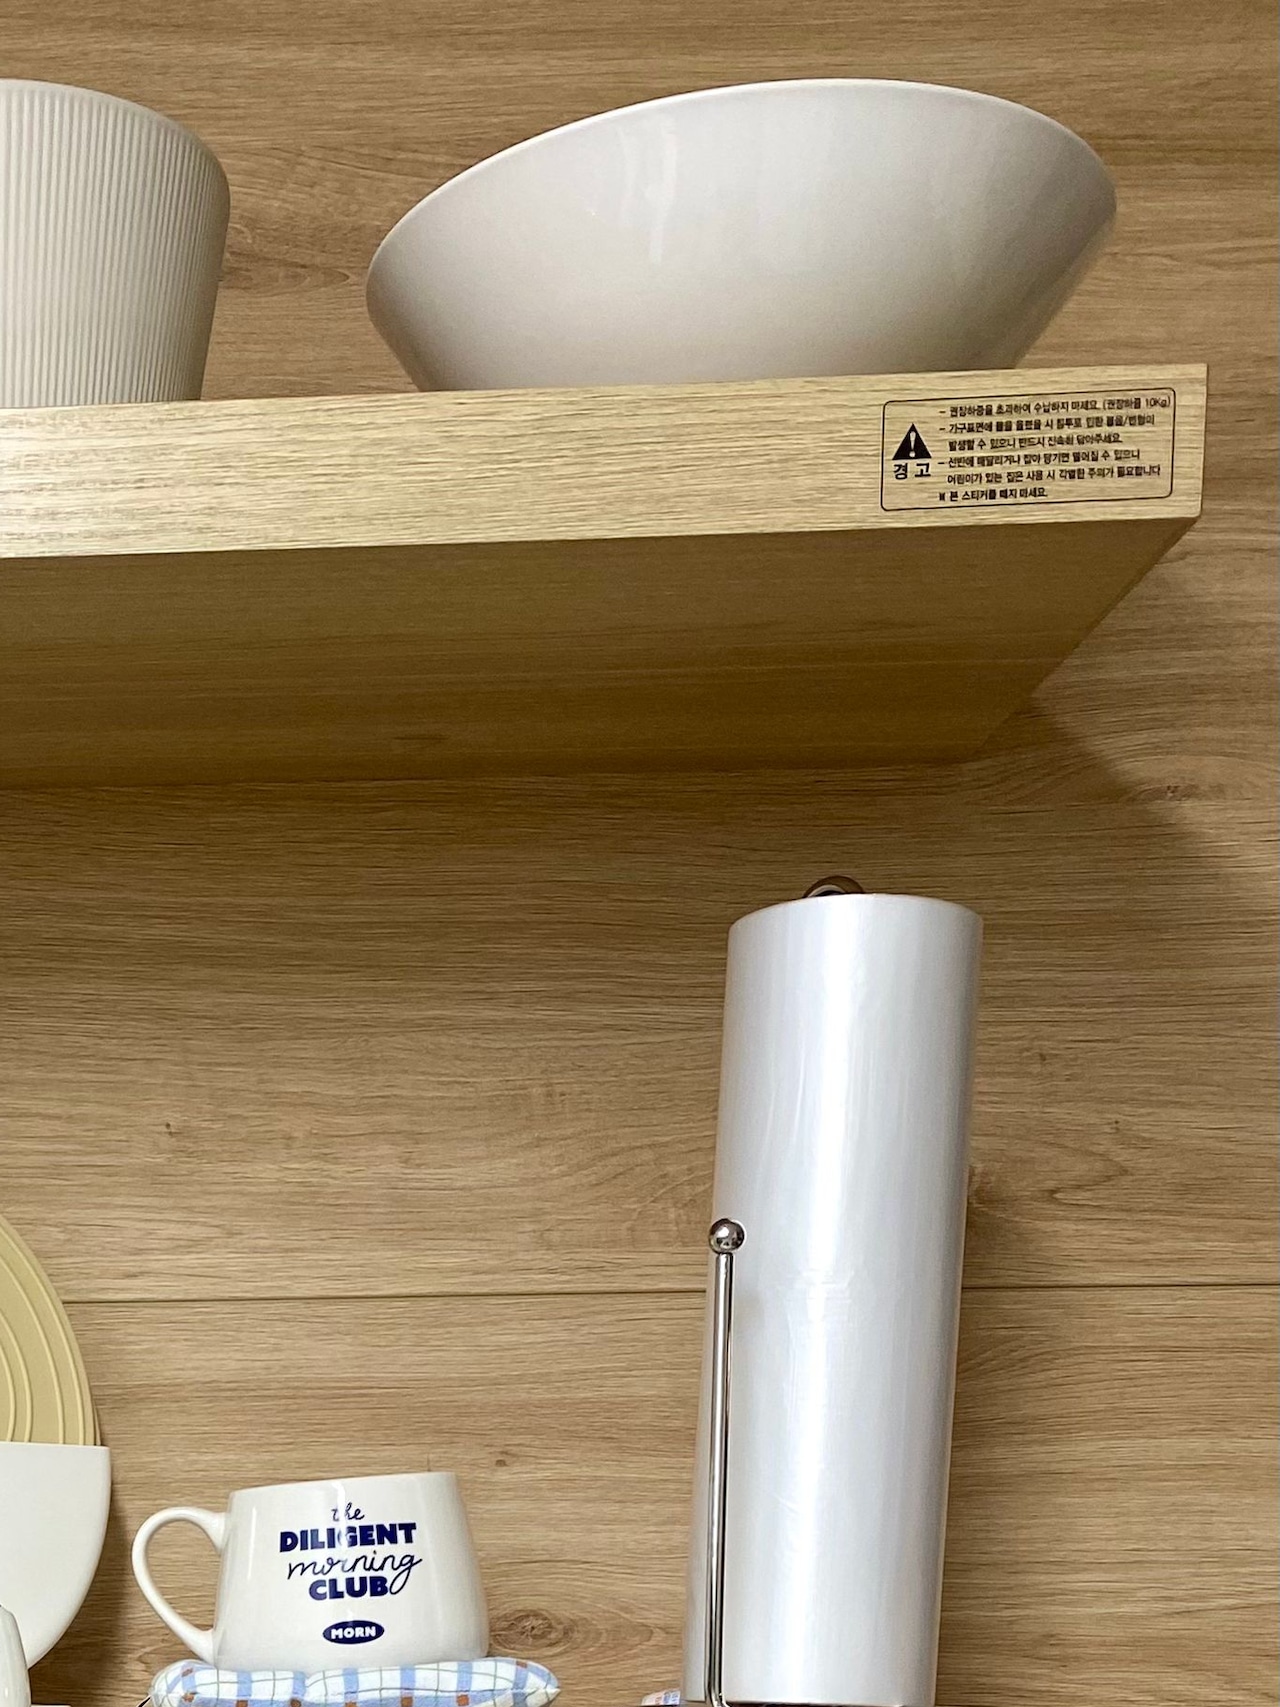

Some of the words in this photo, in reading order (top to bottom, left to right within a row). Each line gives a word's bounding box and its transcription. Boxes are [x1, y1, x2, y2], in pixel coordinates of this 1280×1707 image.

[995, 403, 1031, 415] 초과하여
[949, 421, 993, 434] 가구표면에
[1044, 418, 1053, 430] 시
[977, 438, 986, 450] 수
[990, 437, 1016, 449] 있으니
[1018, 436, 1045, 448] 반드시
[948, 456, 974, 468] 선반에
[977, 454, 1020, 467] 매달리거나
[1043, 452, 1070, 465] 당기면
[1101, 450, 1110, 461] 수
[1113, 448, 1140, 461] 있으니
[947, 472, 983, 485] 어린이가
[985, 471, 1002, 483] 있는
[1026, 469, 1043, 481] 사용
[1046, 469, 1055, 480] 시
[1088, 466, 1114, 478] 주의가
[961, 488, 996, 501] 스티커를
[331, 1501, 365, 1522] the
[279, 1522, 417, 1553] DILIGENT
[287, 1548, 423, 1596] morning
[308, 1576, 389, 1601] CLUB
[329, 1625, 377, 1641] MORN
